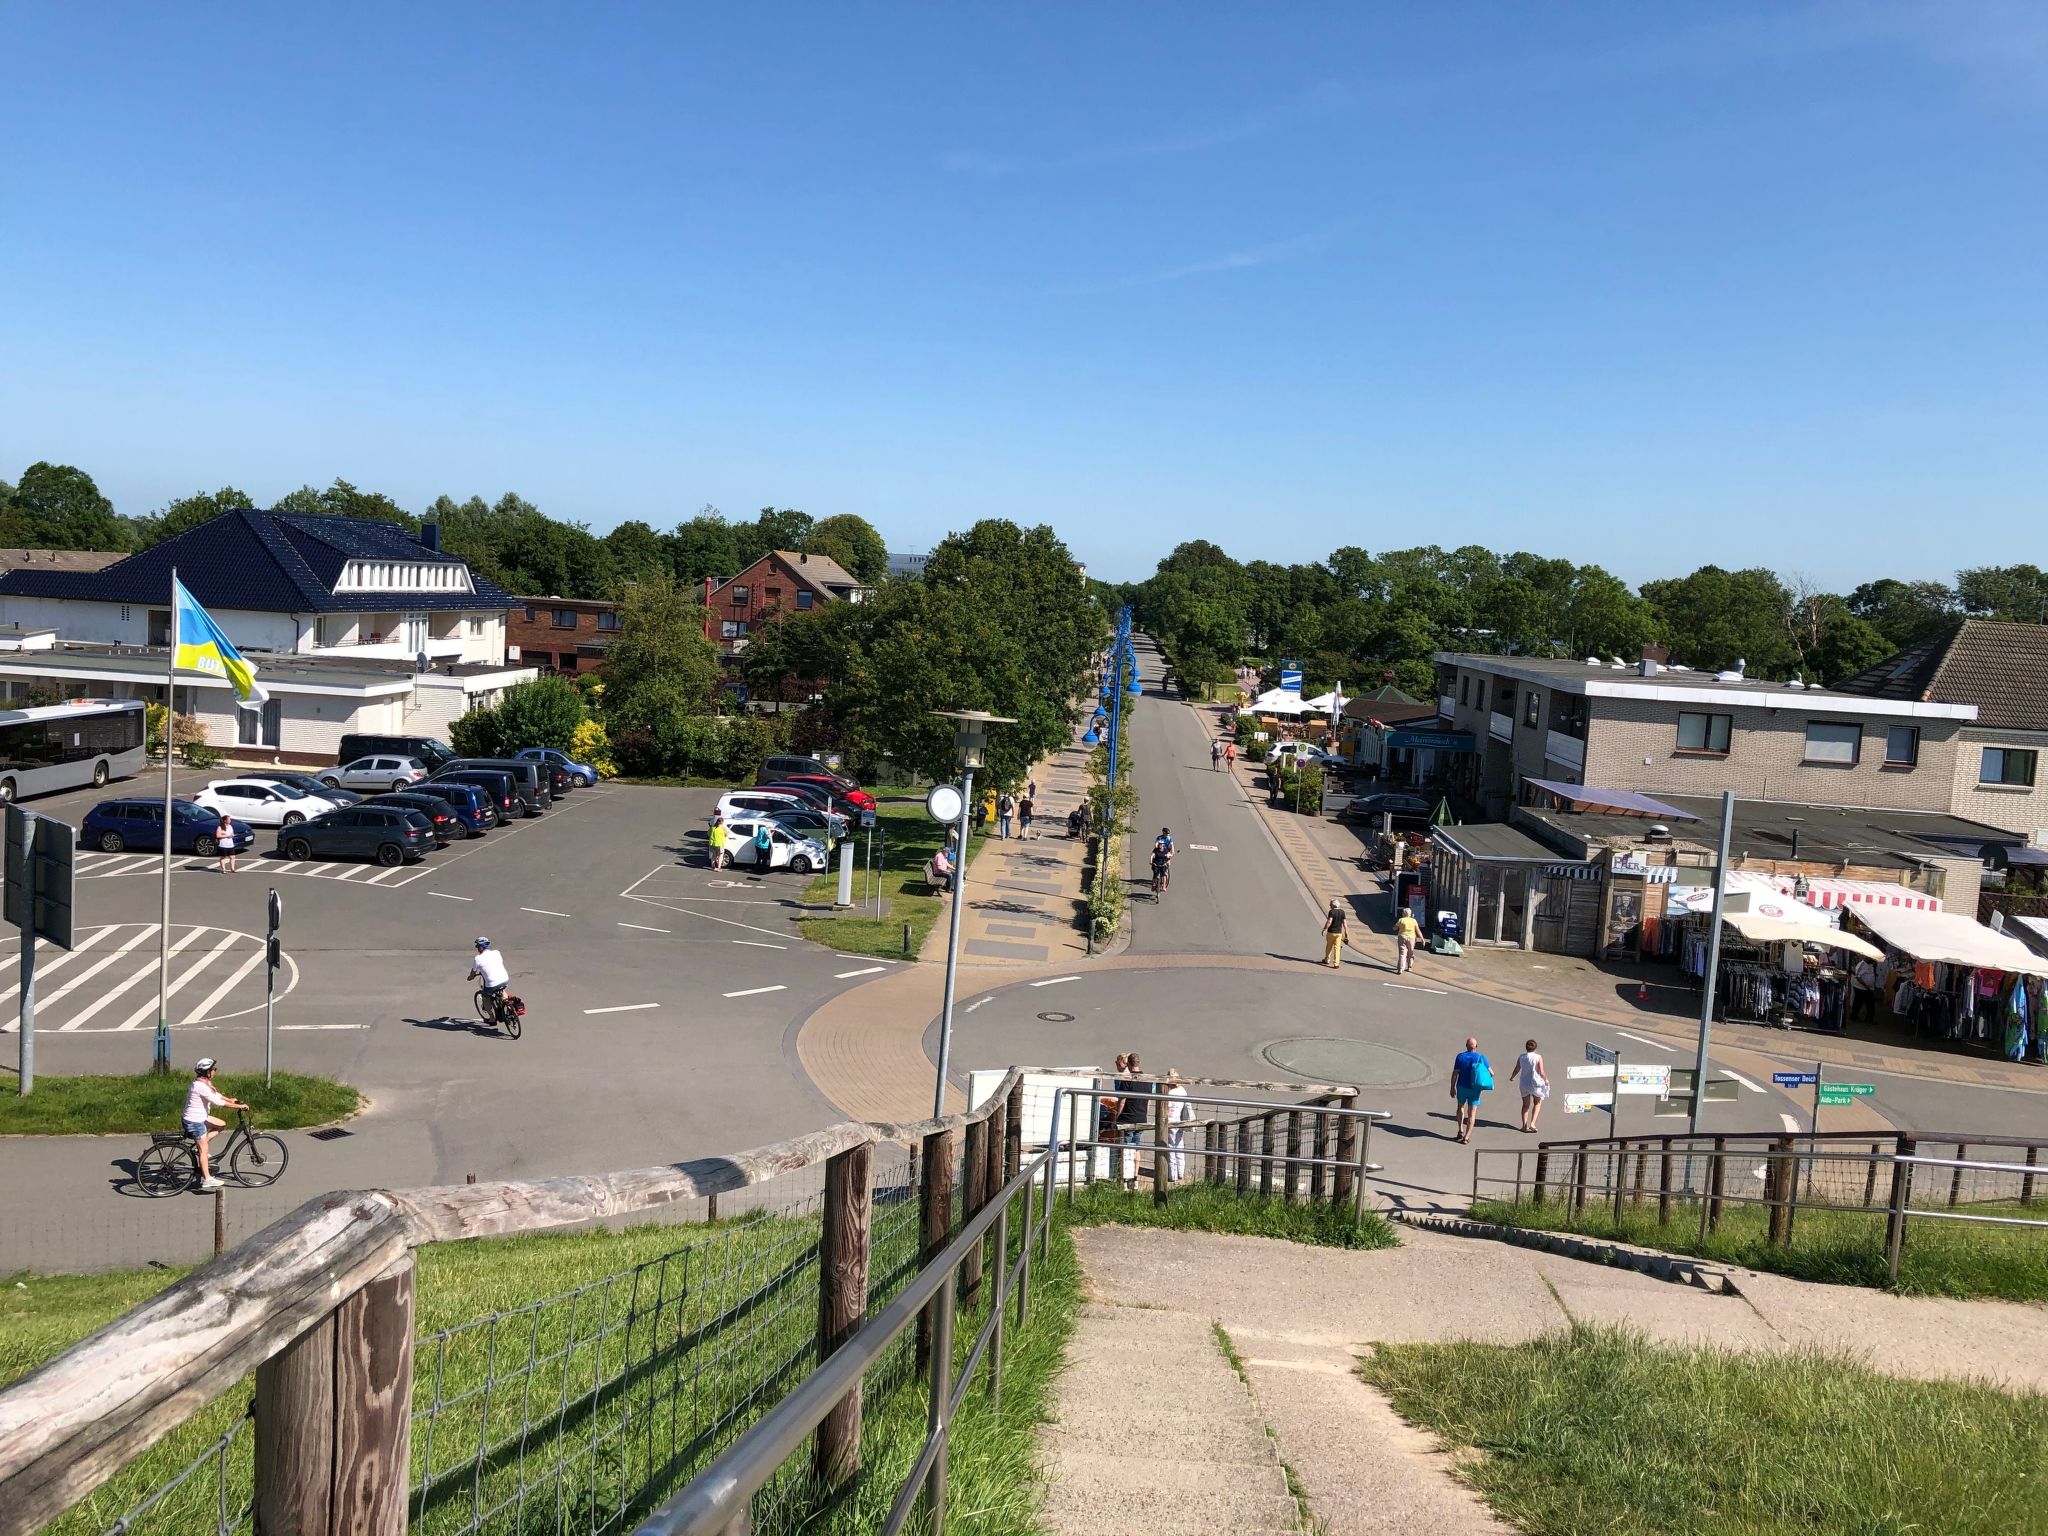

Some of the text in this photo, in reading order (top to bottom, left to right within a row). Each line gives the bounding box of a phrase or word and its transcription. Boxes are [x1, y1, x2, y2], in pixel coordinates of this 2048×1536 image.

[1774, 1074, 1816, 1083] Tossenser Deich
[1823, 1085, 1867, 1094] Gästehaus Krüger
